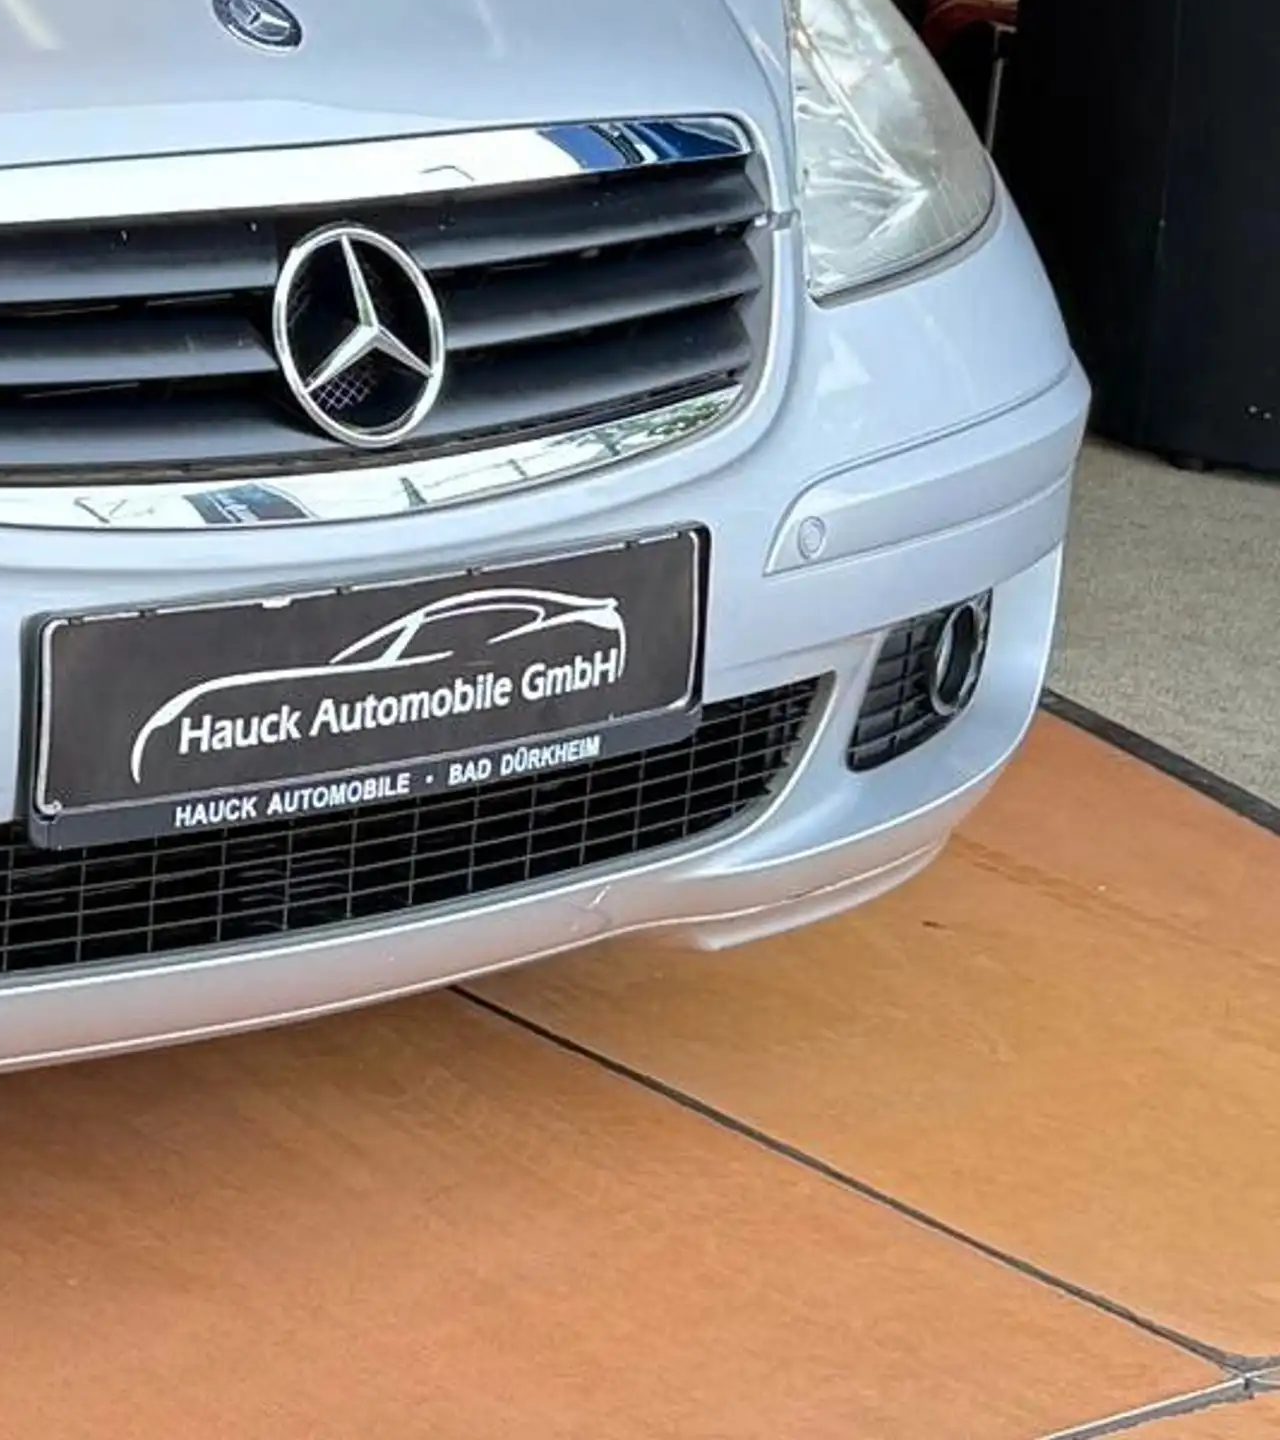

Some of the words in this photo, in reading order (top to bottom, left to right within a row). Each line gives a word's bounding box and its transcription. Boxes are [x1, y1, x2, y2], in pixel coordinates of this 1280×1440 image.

[178, 704, 302, 755] Hauck
[308, 672, 513, 737] Automobile
[521, 648, 618, 701] GmbH
[175, 796, 259, 828] HAUCK
[267, 772, 411, 816] AUTOMOBILE
[448, 759, 492, 786] BAD
